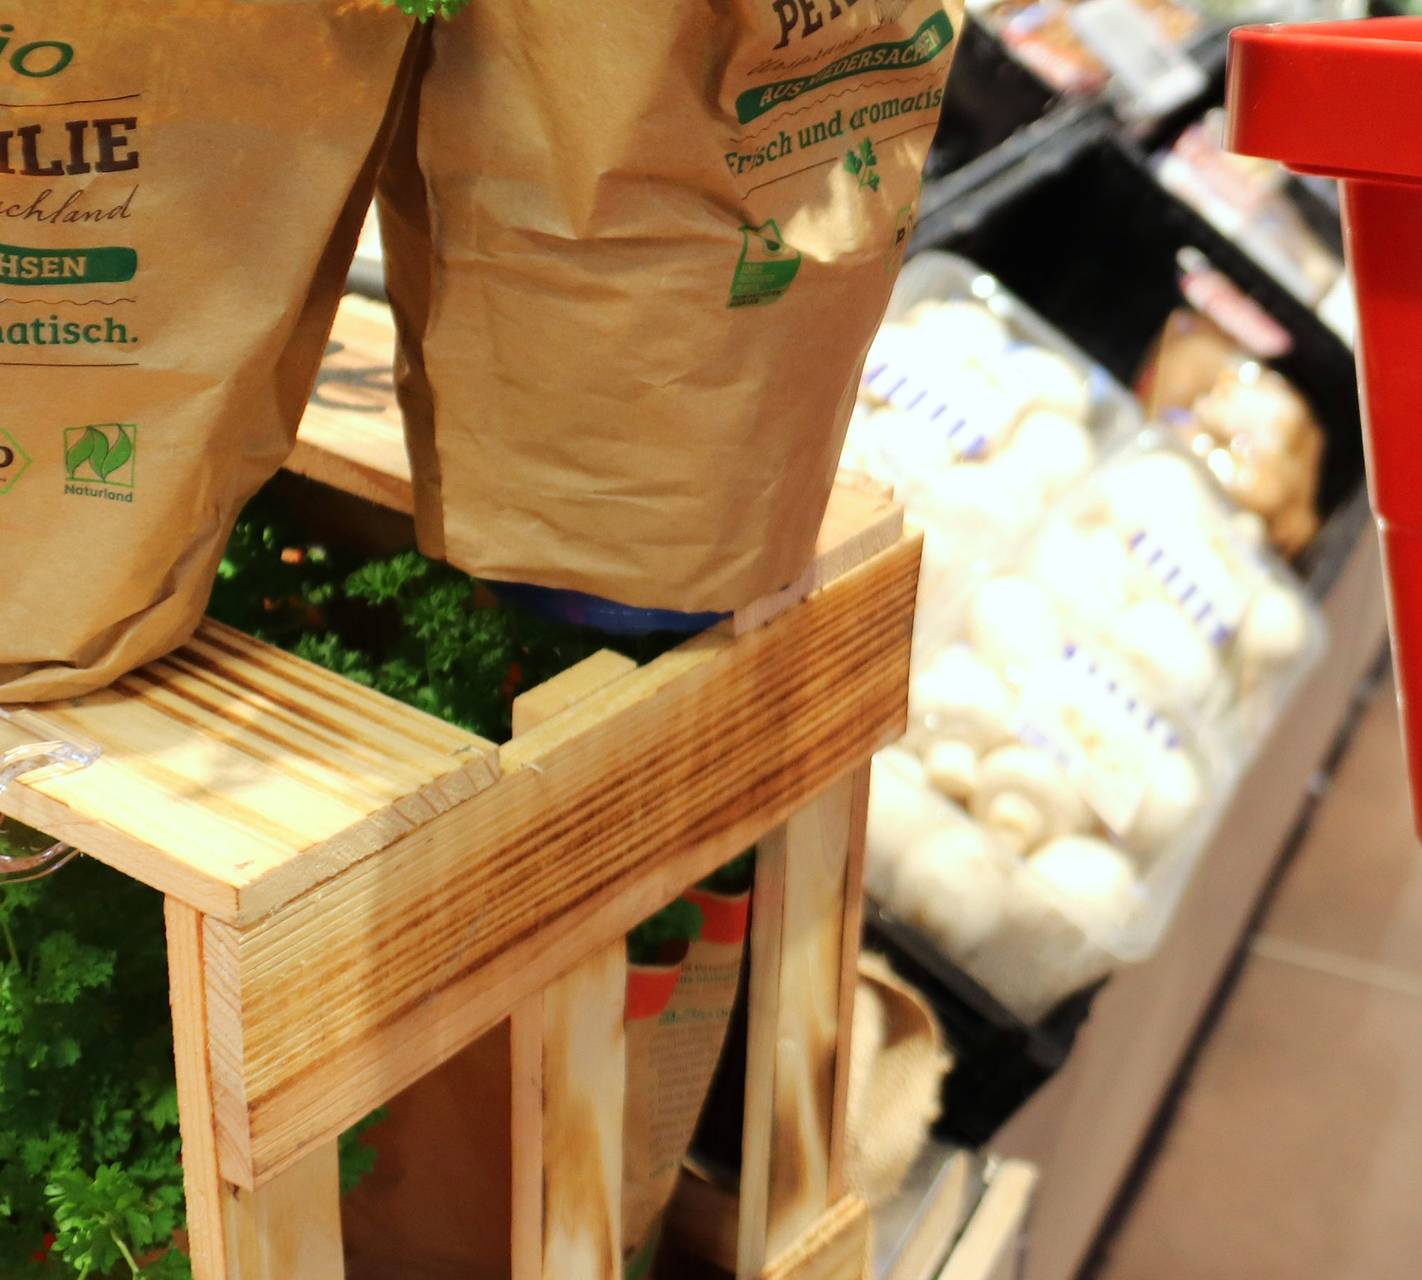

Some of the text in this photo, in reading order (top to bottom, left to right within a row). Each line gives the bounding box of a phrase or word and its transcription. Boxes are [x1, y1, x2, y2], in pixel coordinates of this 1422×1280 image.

[759, 80, 806, 107] AUS
[798, 110, 844, 149] und
[0, 183, 140, 224] chland
[64, 484, 134, 504] Naturland
